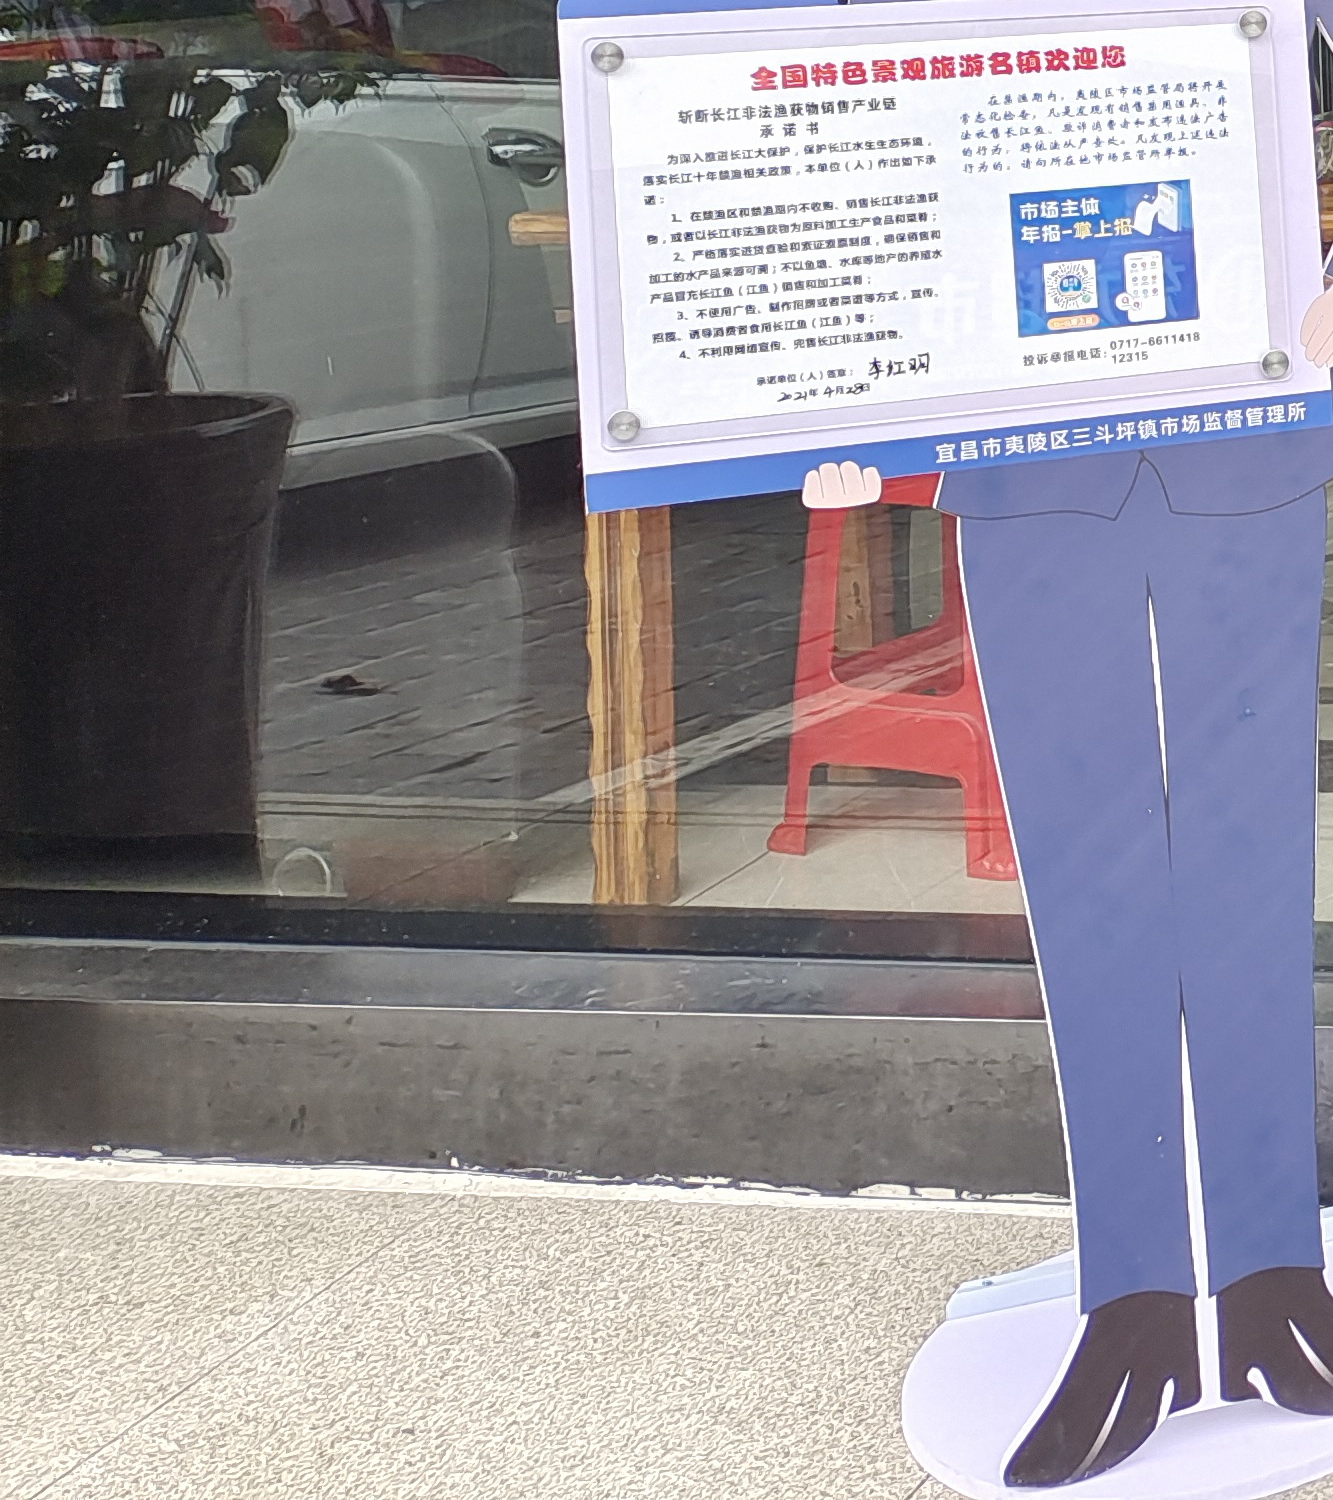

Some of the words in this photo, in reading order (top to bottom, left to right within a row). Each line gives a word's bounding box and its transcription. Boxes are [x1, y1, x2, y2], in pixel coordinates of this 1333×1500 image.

[750, 45, 1126, 92] 全国特色景观旅游名镇欢迎您
[678, 96, 897, 124] 斩断长江非法渔获物销售产业链
[760, 121, 819, 138] 承诺书
[1019, 198, 1101, 221] 市场主体
[1110, 332, 1201, 350] 0717-6611418
[1112, 351, 1149, 364] 12315
[935, 401, 1307, 464] 宜昌市夷陵区三斗坪镇市场监督管理所
